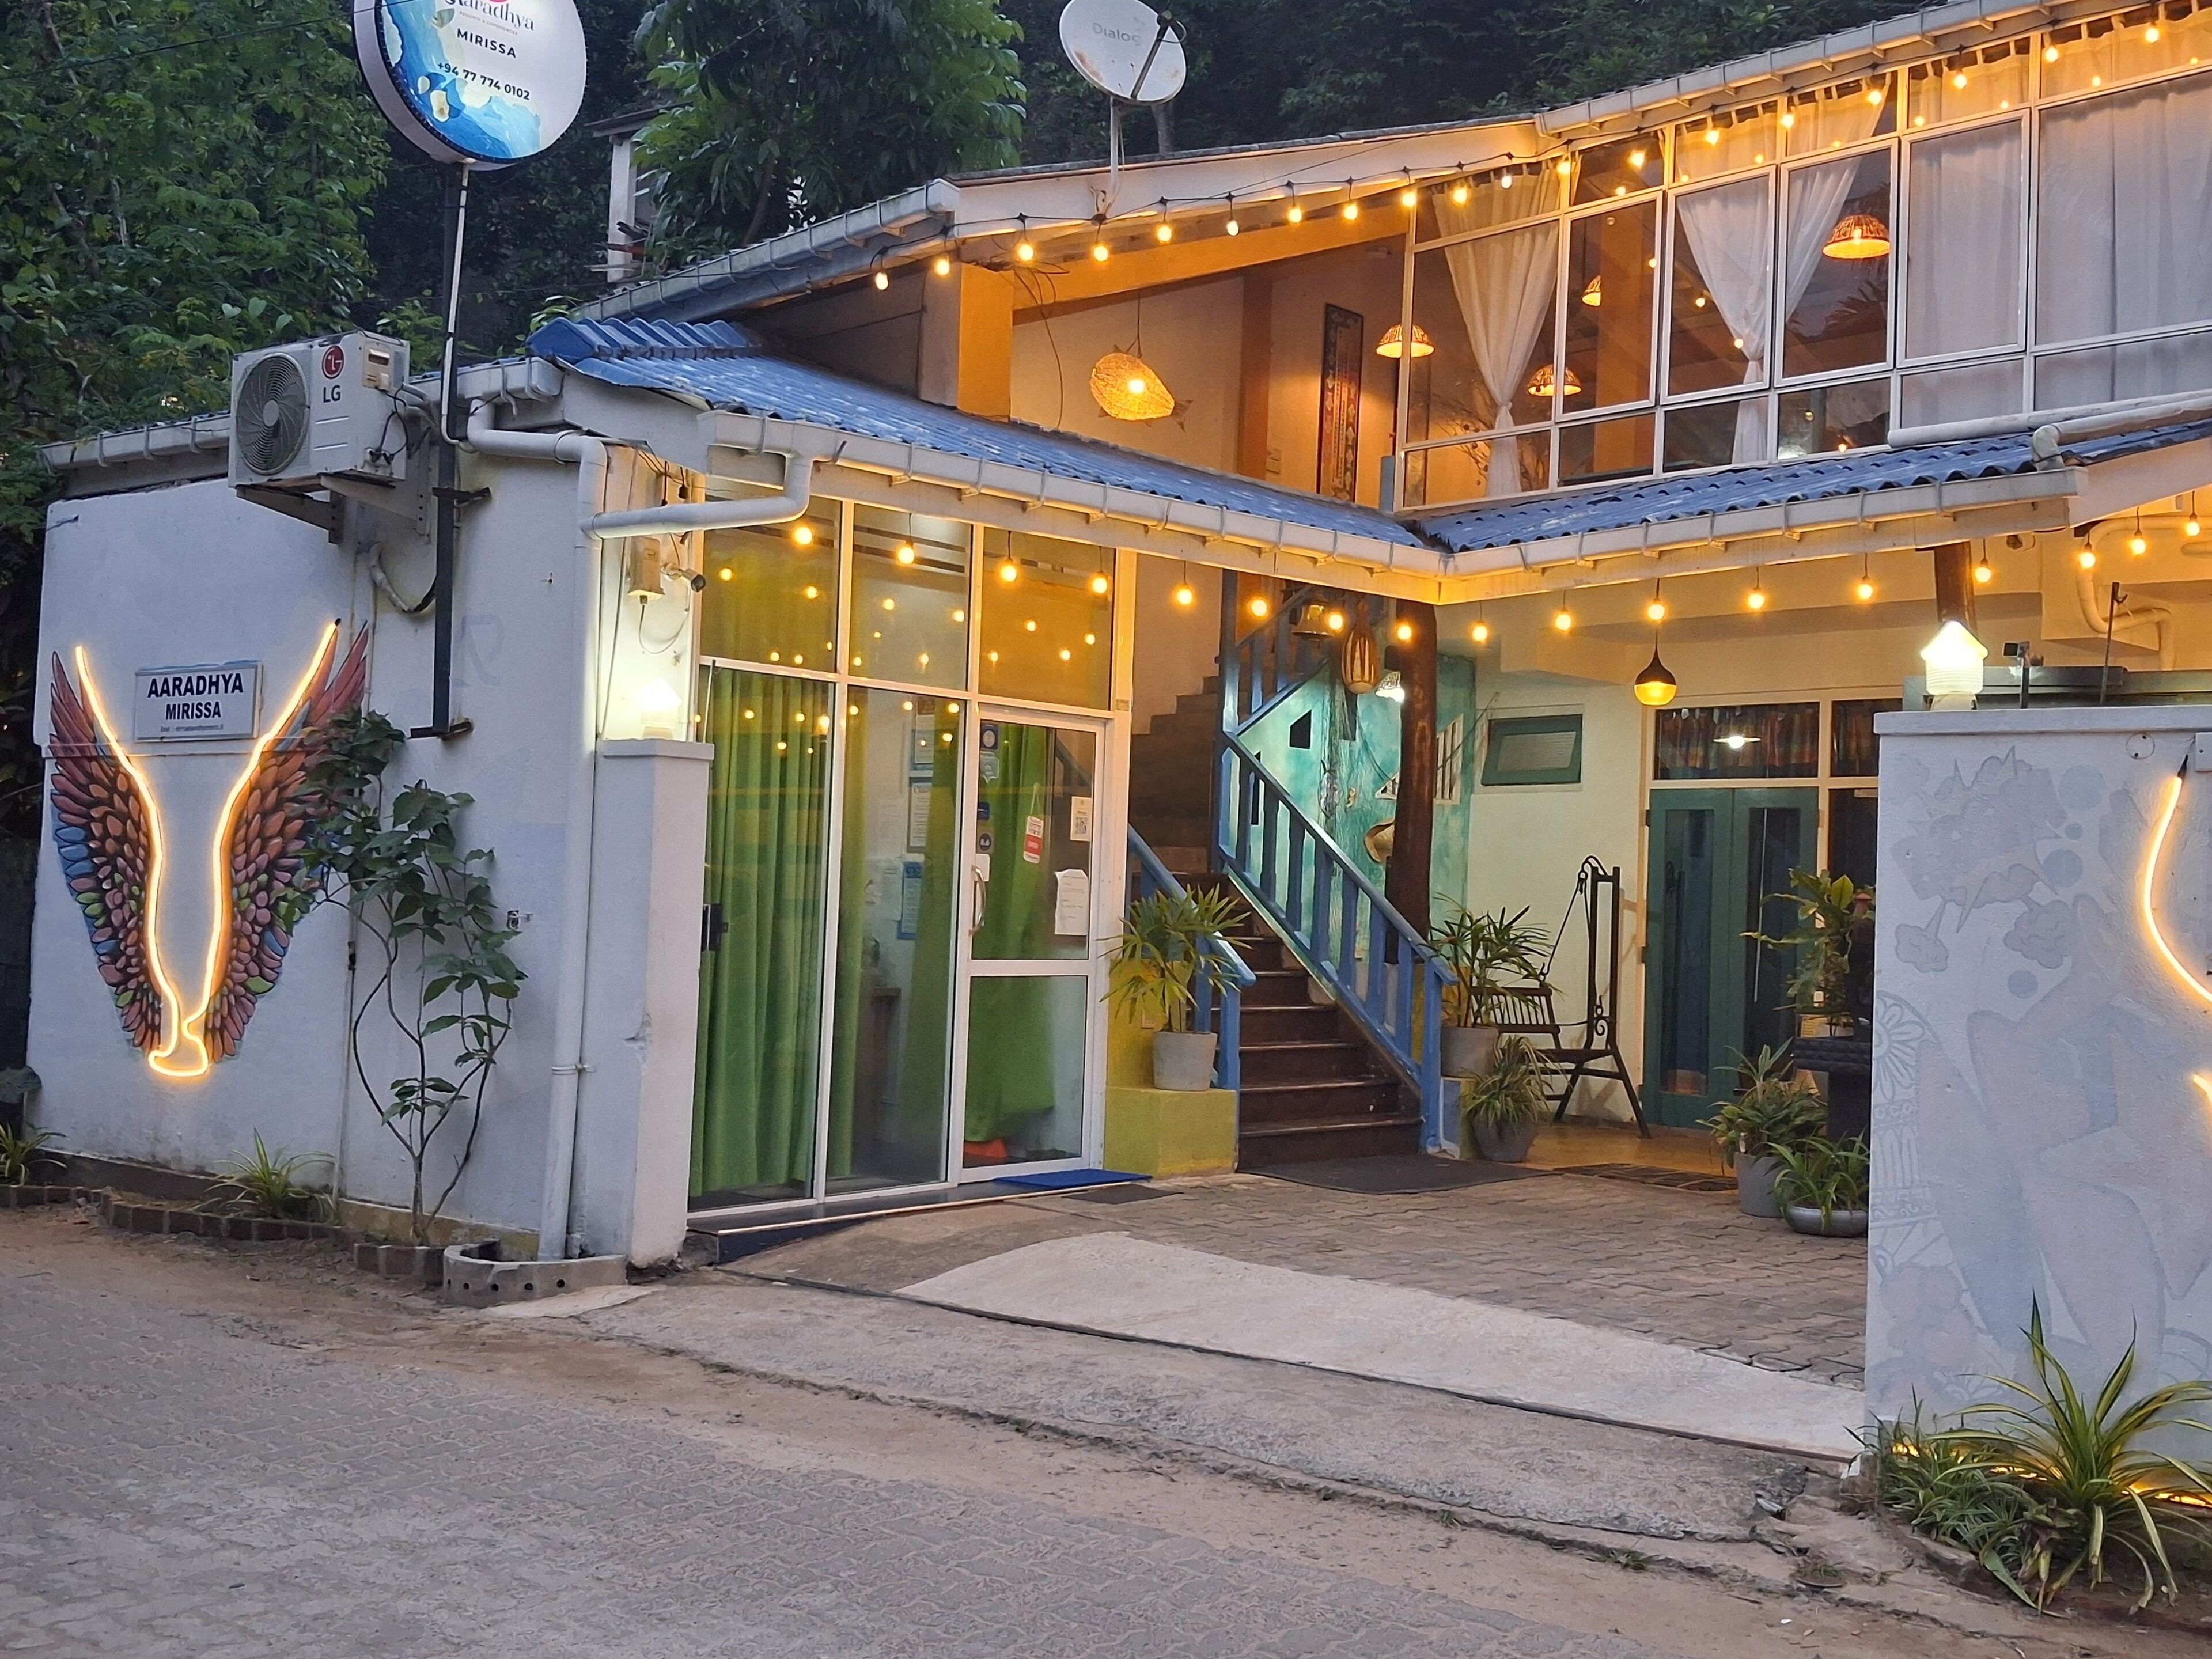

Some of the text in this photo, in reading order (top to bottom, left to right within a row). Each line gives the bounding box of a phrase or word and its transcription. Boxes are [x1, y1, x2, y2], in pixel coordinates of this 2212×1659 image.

[445, 0, 535, 31] aradhya
[457, 28, 516, 58] MIRISSA
[438, 62, 530, 100] +94 77 774 0102
[323, 384, 341, 403] LG
[147, 673, 244, 698] AARADHYA
[166, 702, 221, 720] MIRISSA
